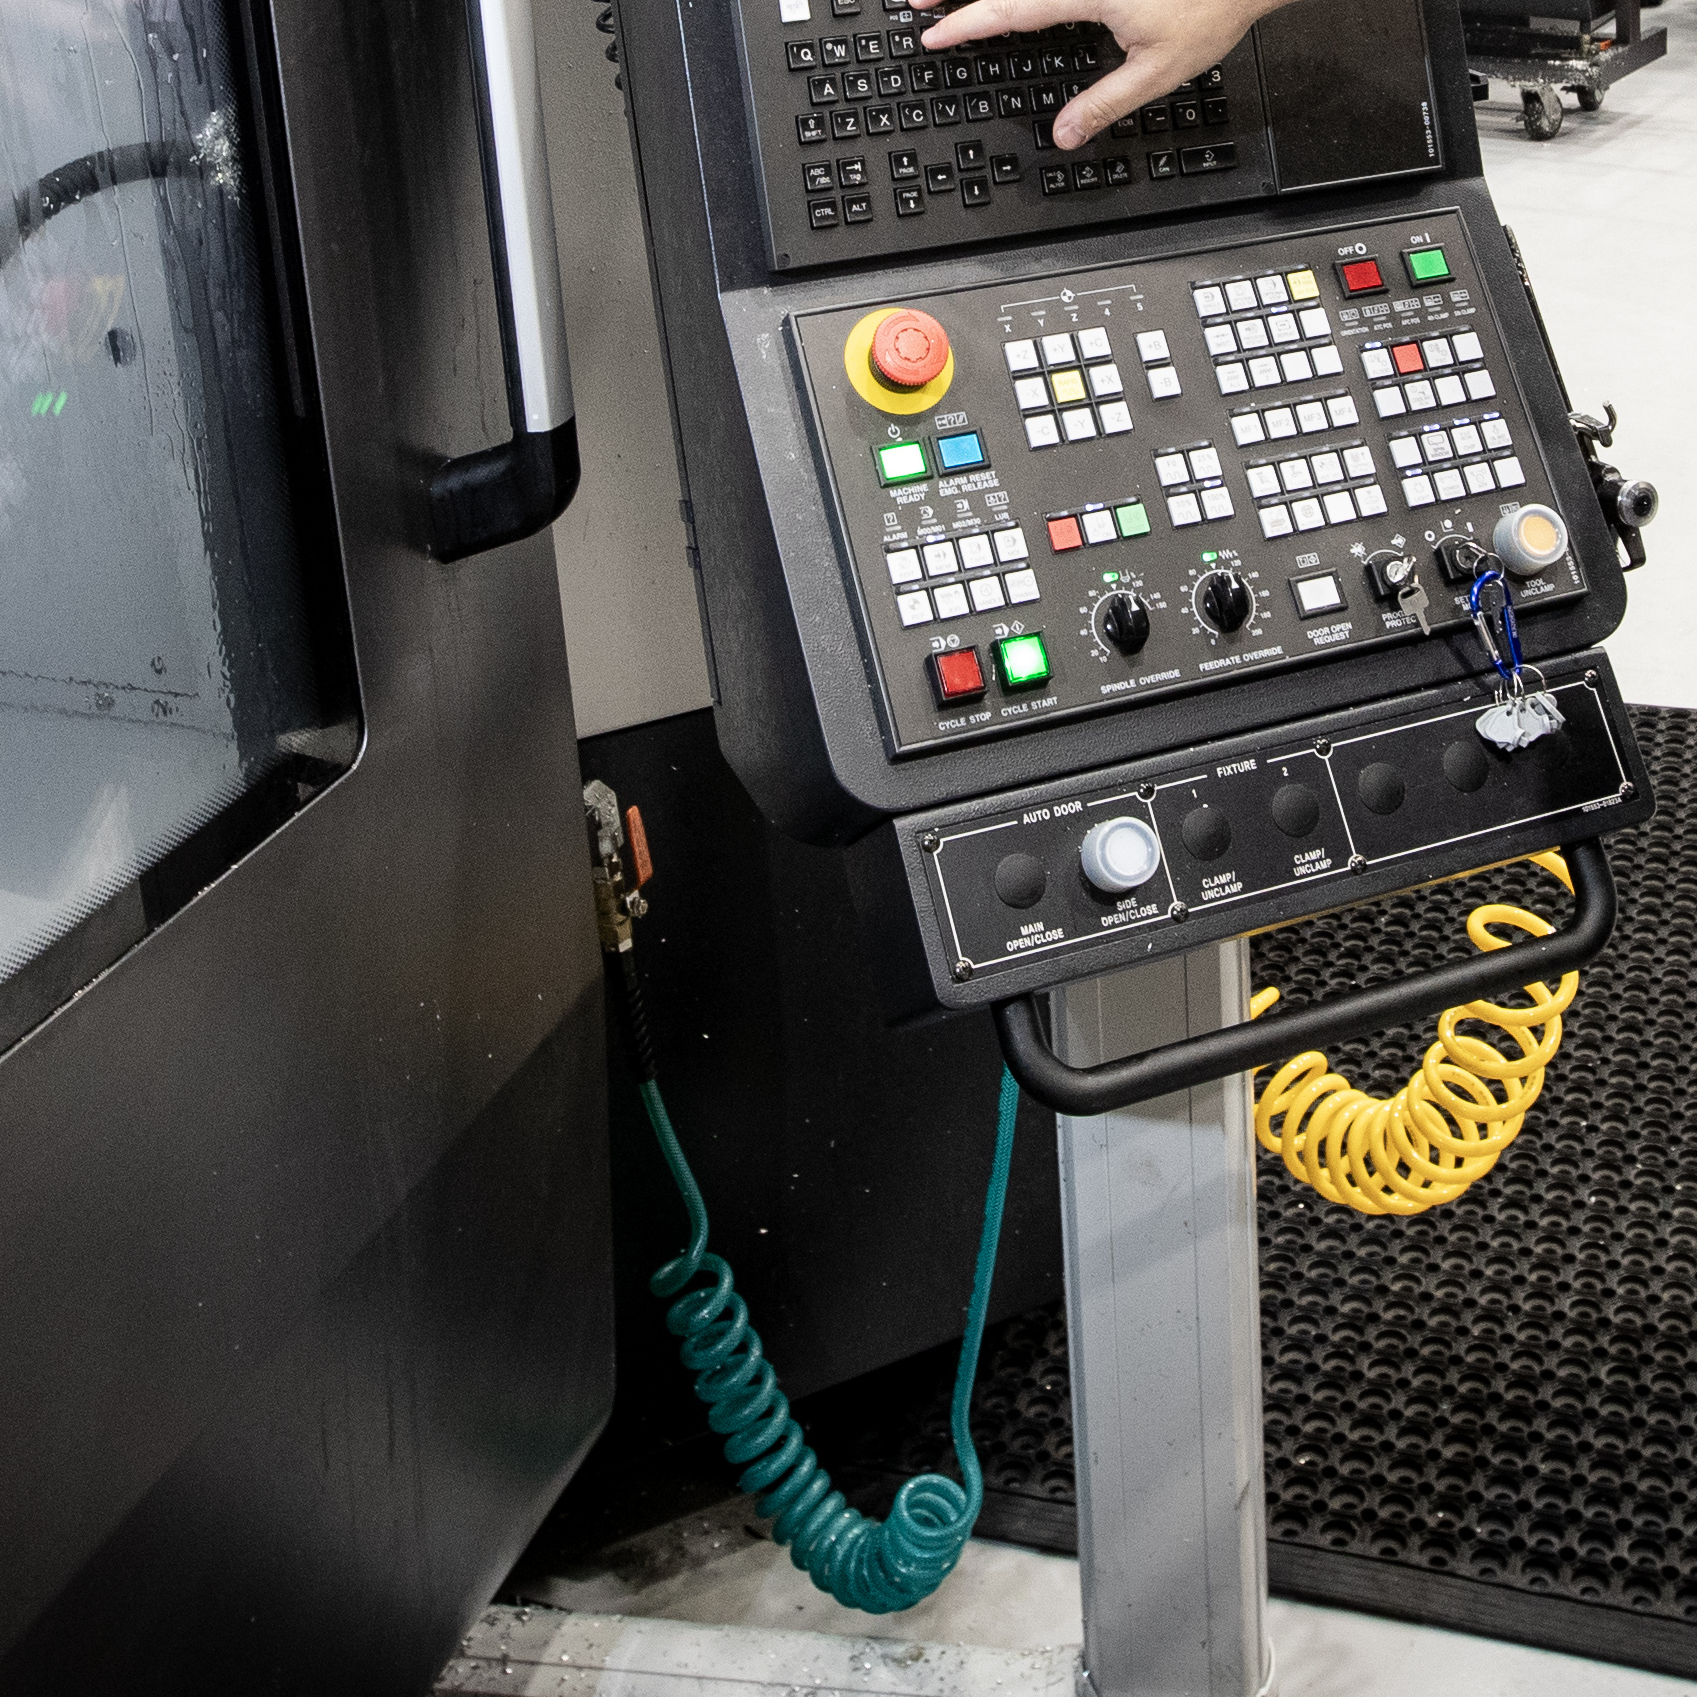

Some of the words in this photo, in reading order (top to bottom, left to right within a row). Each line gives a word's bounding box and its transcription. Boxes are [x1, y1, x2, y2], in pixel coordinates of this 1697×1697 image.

[815, 208, 834, 217] CTRL
[852, 203, 866, 212] ALT
[1410, 234, 1423, 244] ON
[1338, 246, 1354, 256] OFF
[1104, 307, 1111, 317] 4
[1136, 302, 1144, 311] 5
[1037, 318, 1044, 327] Y
[1071, 313, 1078, 322] Z
[1004, 324, 1011, 333] X
[938, 476, 968, 489] ALARM
[969, 471, 996, 483] RESET
[889, 484, 929, 498] MACHINE
[940, 487, 959, 497] EMG.
[962, 479, 1000, 493] RELEASE
[897, 493, 926, 505] READY
[883, 532, 908, 542] ALARM
[1526, 578, 1546, 588] TOOL
[1520, 583, 1555, 598] UNCLAMP
[1385, 616, 1417, 629] PROTEC
[1306, 628, 1330, 639] DOOR
[1331, 622, 1352, 633] OPEN
[1314, 631, 1350, 645] REQUEST
[1199, 655, 1241, 672] FEEDRATE
[1243, 646, 1283, 661] OVERRIDE
[1100, 679, 1136, 694] SPINDLE
[1139, 669, 1181, 685] OVERRIDE
[1001, 704, 1029, 717] CYCLE
[1031, 697, 1058, 710] START
[938, 717, 966, 731] CYCLE
[969, 712, 992, 725] STOP
[1216, 759, 1257, 778] FIXTURE
[1282, 767, 1289, 776] 2
[1191, 788, 1197, 798] 1
[1023, 809, 1050, 825] AUTO
[1053, 801, 1083, 817] DOOR
[1294, 848, 1325, 865] CLAMP/
[1293, 858, 1332, 877] UNCLAMP
[1202, 871, 1235, 888] CLAMP/
[1201, 882, 1243, 901] UNCLAMP
[1116, 897, 1137, 911] SIDE
[1101, 904, 1159, 927] OPEN/CLOSE
[1020, 922, 1044, 936] MAIN
[1006, 928, 1064, 952] OPEN/CLOSE
